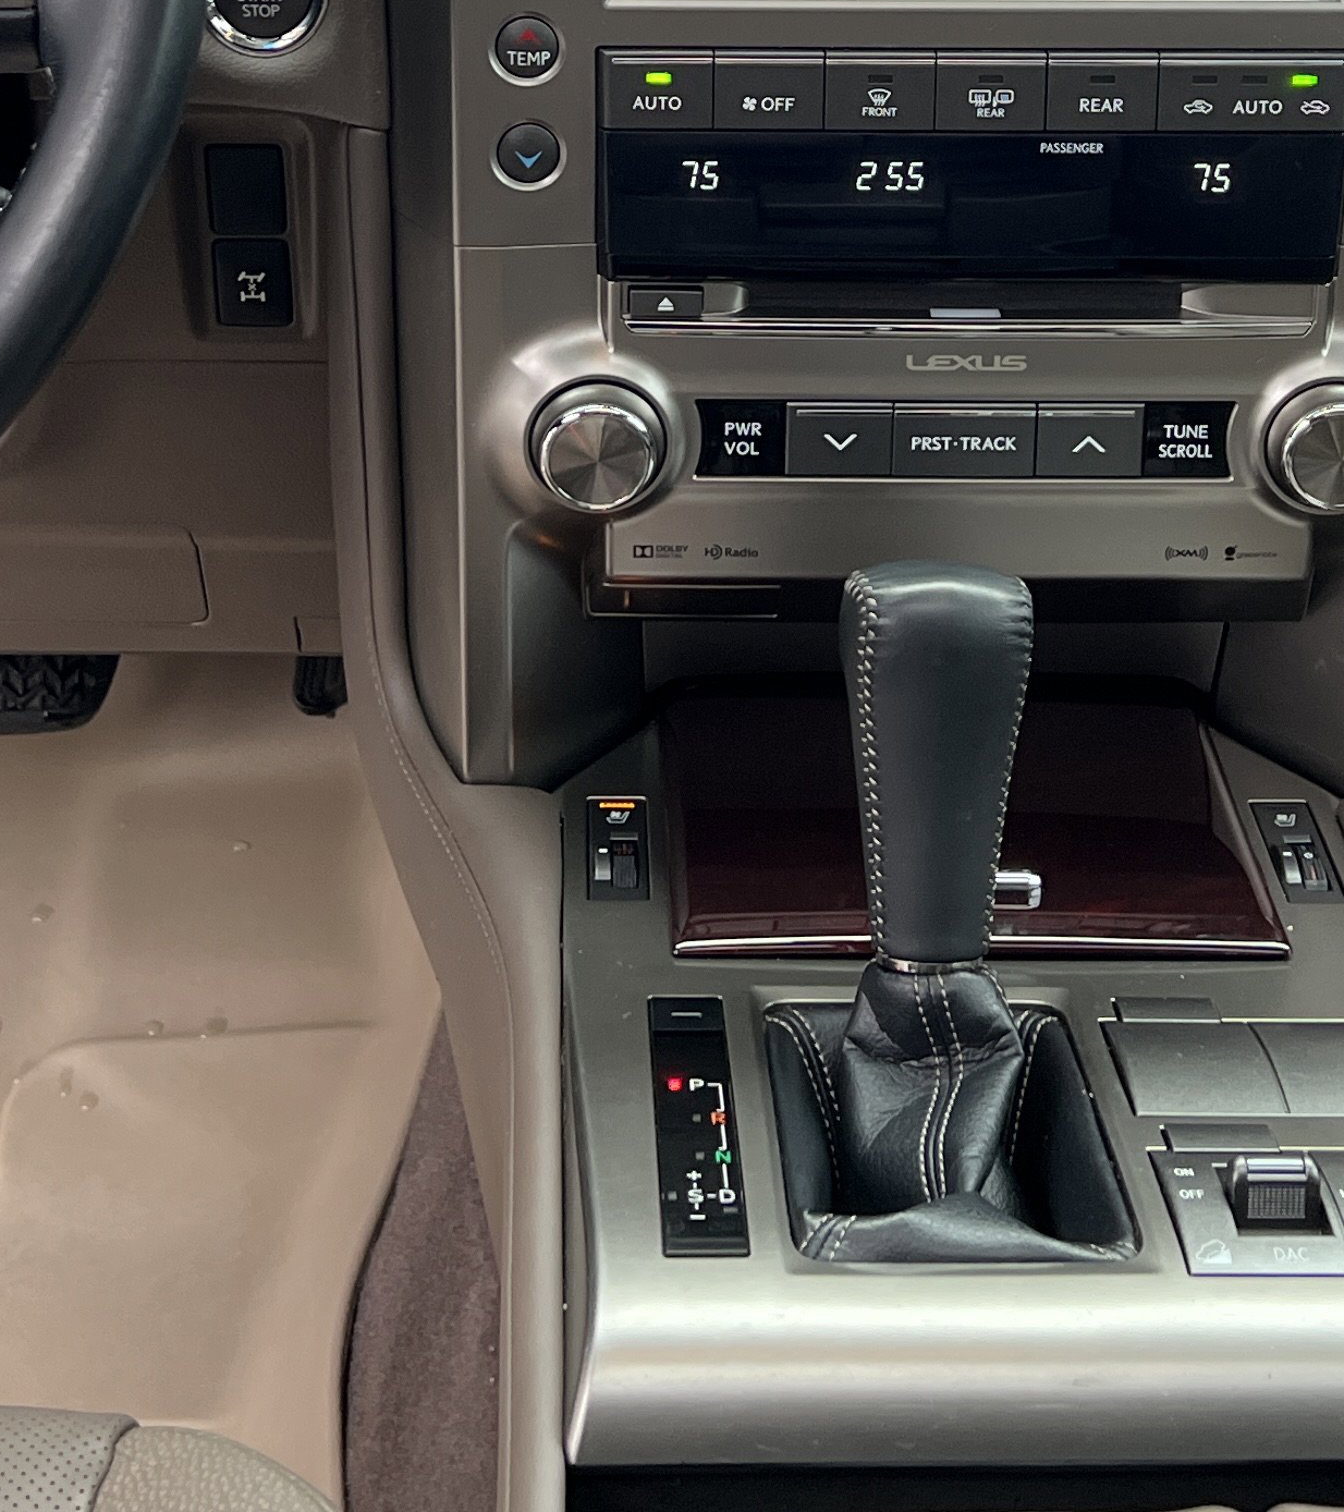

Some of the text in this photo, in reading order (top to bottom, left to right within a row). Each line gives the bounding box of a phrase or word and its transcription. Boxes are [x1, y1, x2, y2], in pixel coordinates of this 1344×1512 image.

[241, 3, 281, 18] STOP
[507, 51, 552, 67] TEMP
[632, 95, 682, 112] AUTO
[761, 96, 796, 113] OFF
[861, 106, 898, 118] FRONT
[1079, 98, 1124, 114] REAR
[1232, 99, 1283, 116] AUTO
[976, 107, 1006, 119] REAR
[1039, 141, 1105, 155] PASSENGER
[682, 160, 720, 191] 75
[1193, 162, 1232, 193] 75
[905, 354, 1028, 372] LEXUS
[723, 421, 763, 438] PWR
[1163, 423, 1209, 440] TUNE
[723, 440, 761, 457] VOL
[1158, 442, 1213, 459] SCROLL
[656, 544, 689, 553] DOLBY
[724, 547, 759, 558] Radio
[688, 1077, 705, 1092] P
[714, 1149, 732, 1165] N
[718, 1187, 736, 1205] D
[1178, 1189, 1205, 1200] OFF
[1272, 1247, 1311, 1264] DAC
